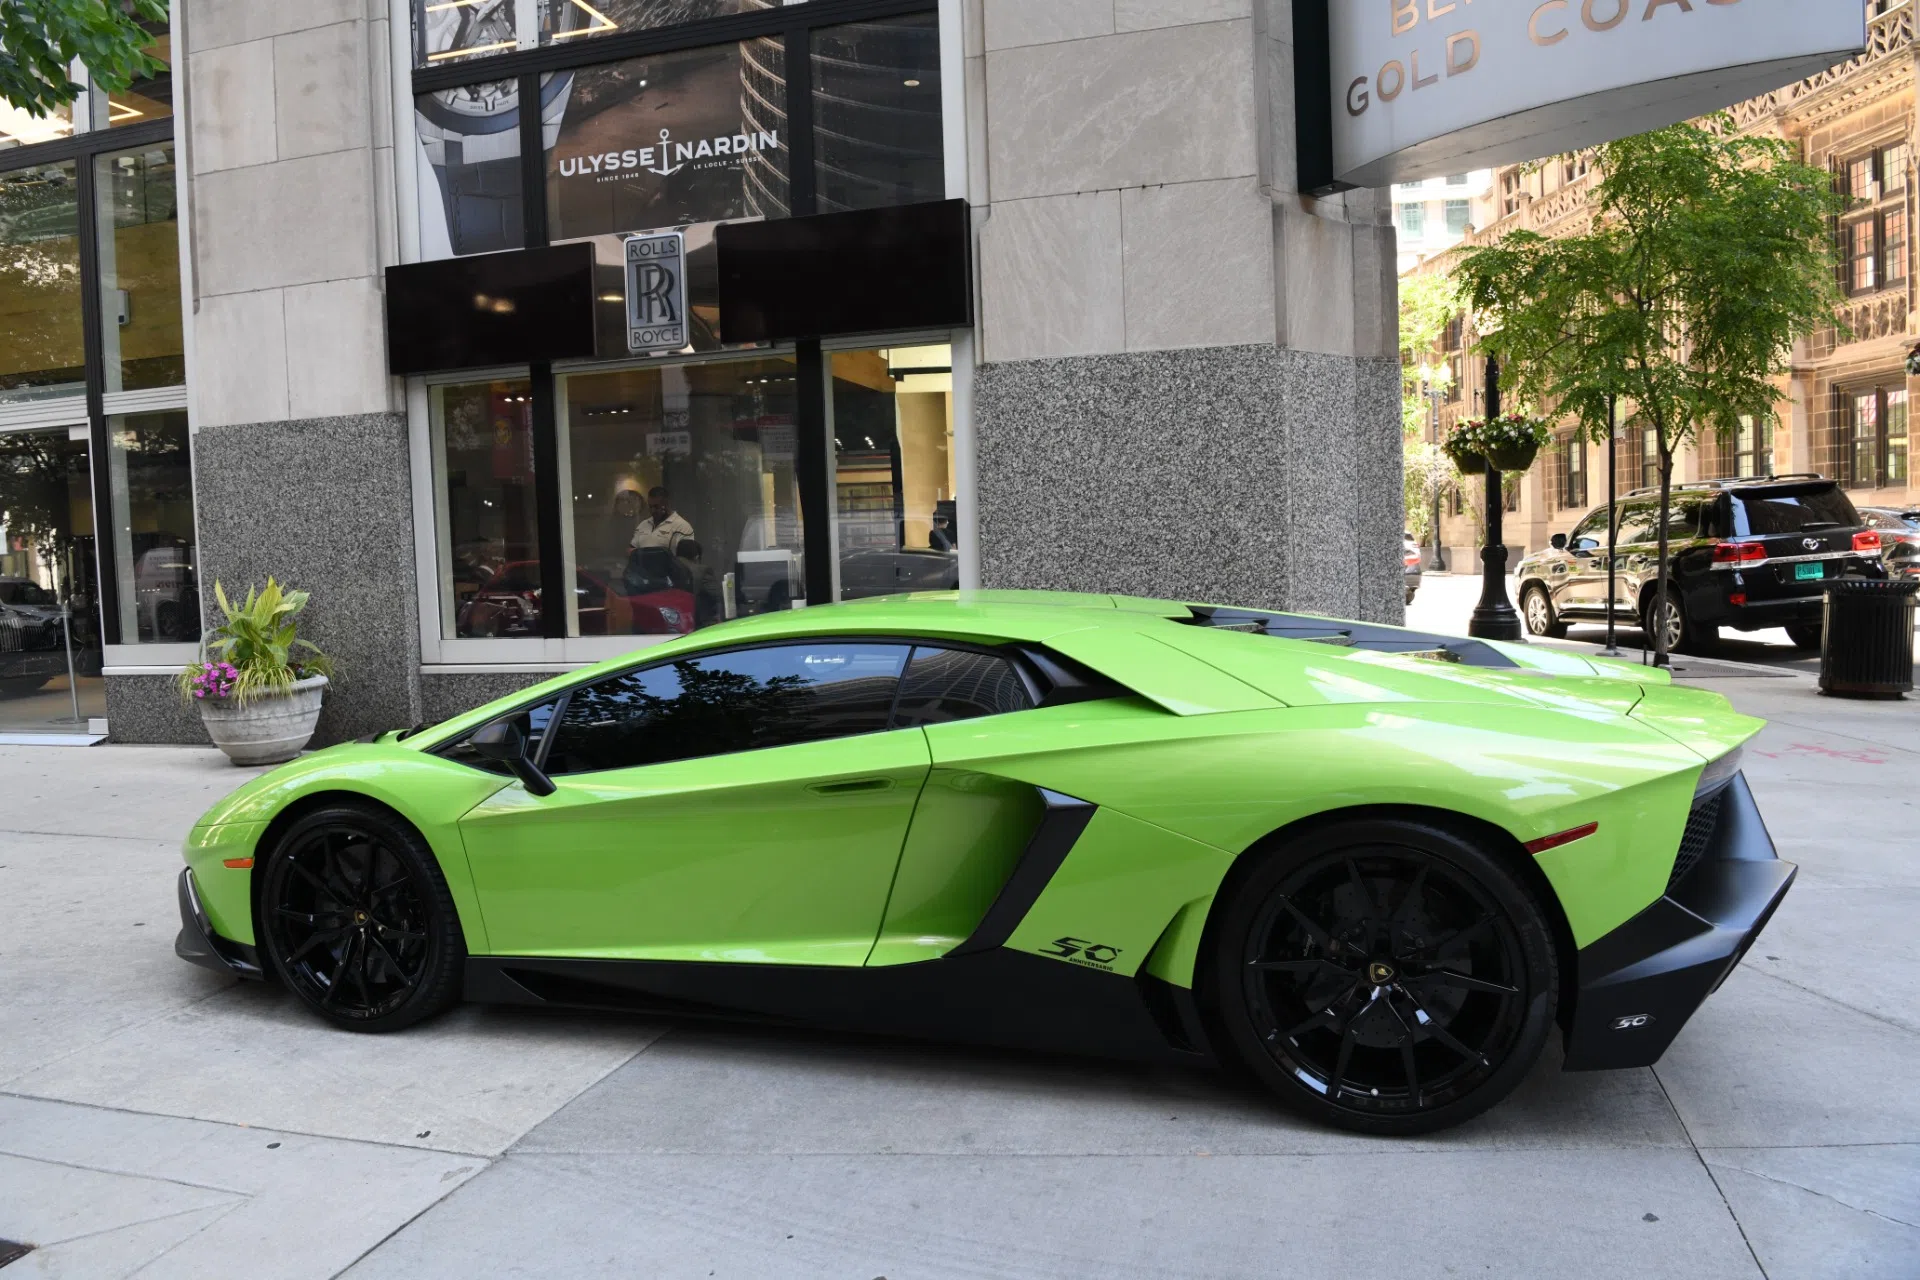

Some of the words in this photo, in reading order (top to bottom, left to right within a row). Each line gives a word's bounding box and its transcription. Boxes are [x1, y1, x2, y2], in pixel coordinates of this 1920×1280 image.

[1346, 29, 1481, 117] GOLD
[1528, 0, 1743, 46] CO
[559, 147, 655, 177] ULYSSE
[675, 130, 778, 161] NARDIN
[704, 161, 727, 169] LOCLE
[596, 175, 619, 183] SINCE
[630, 240, 676, 257] ROLLS
[633, 328, 679, 345] ROYCE
[1069, 957, 1114, 972] ANNIVERSARIO
